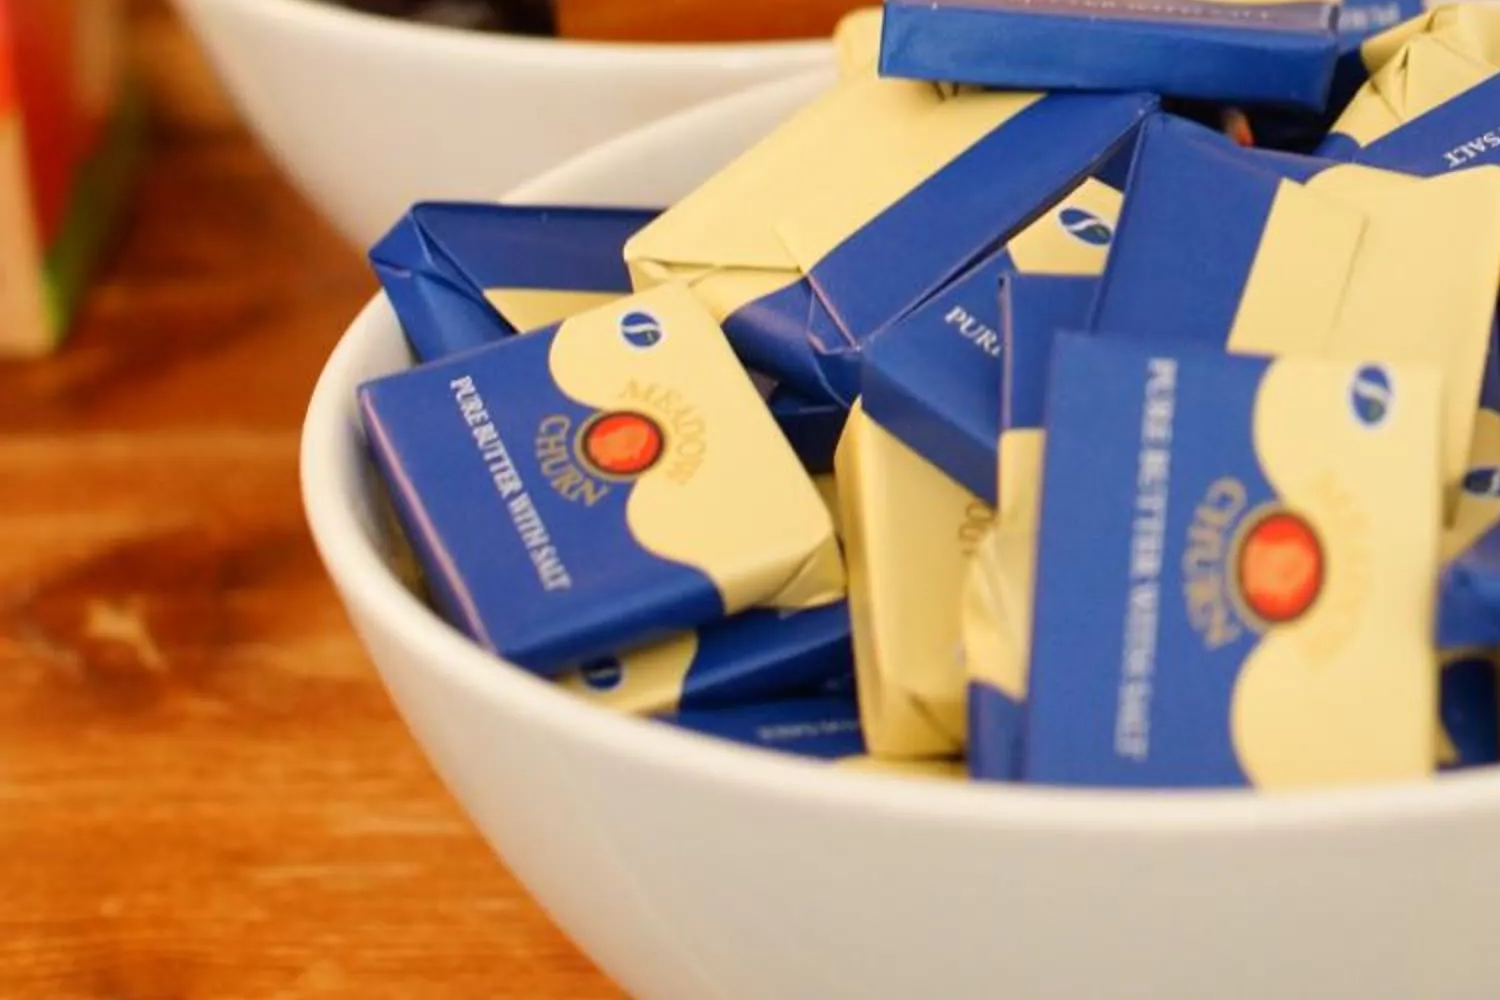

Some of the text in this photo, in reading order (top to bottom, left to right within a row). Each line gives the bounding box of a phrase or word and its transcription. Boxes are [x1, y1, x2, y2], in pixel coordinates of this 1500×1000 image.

[1441, 131, 1500, 168] SALT
[450, 375, 572, 591] PURE BUTTER WITH SALT
[535, 415, 611, 506] CHURN
